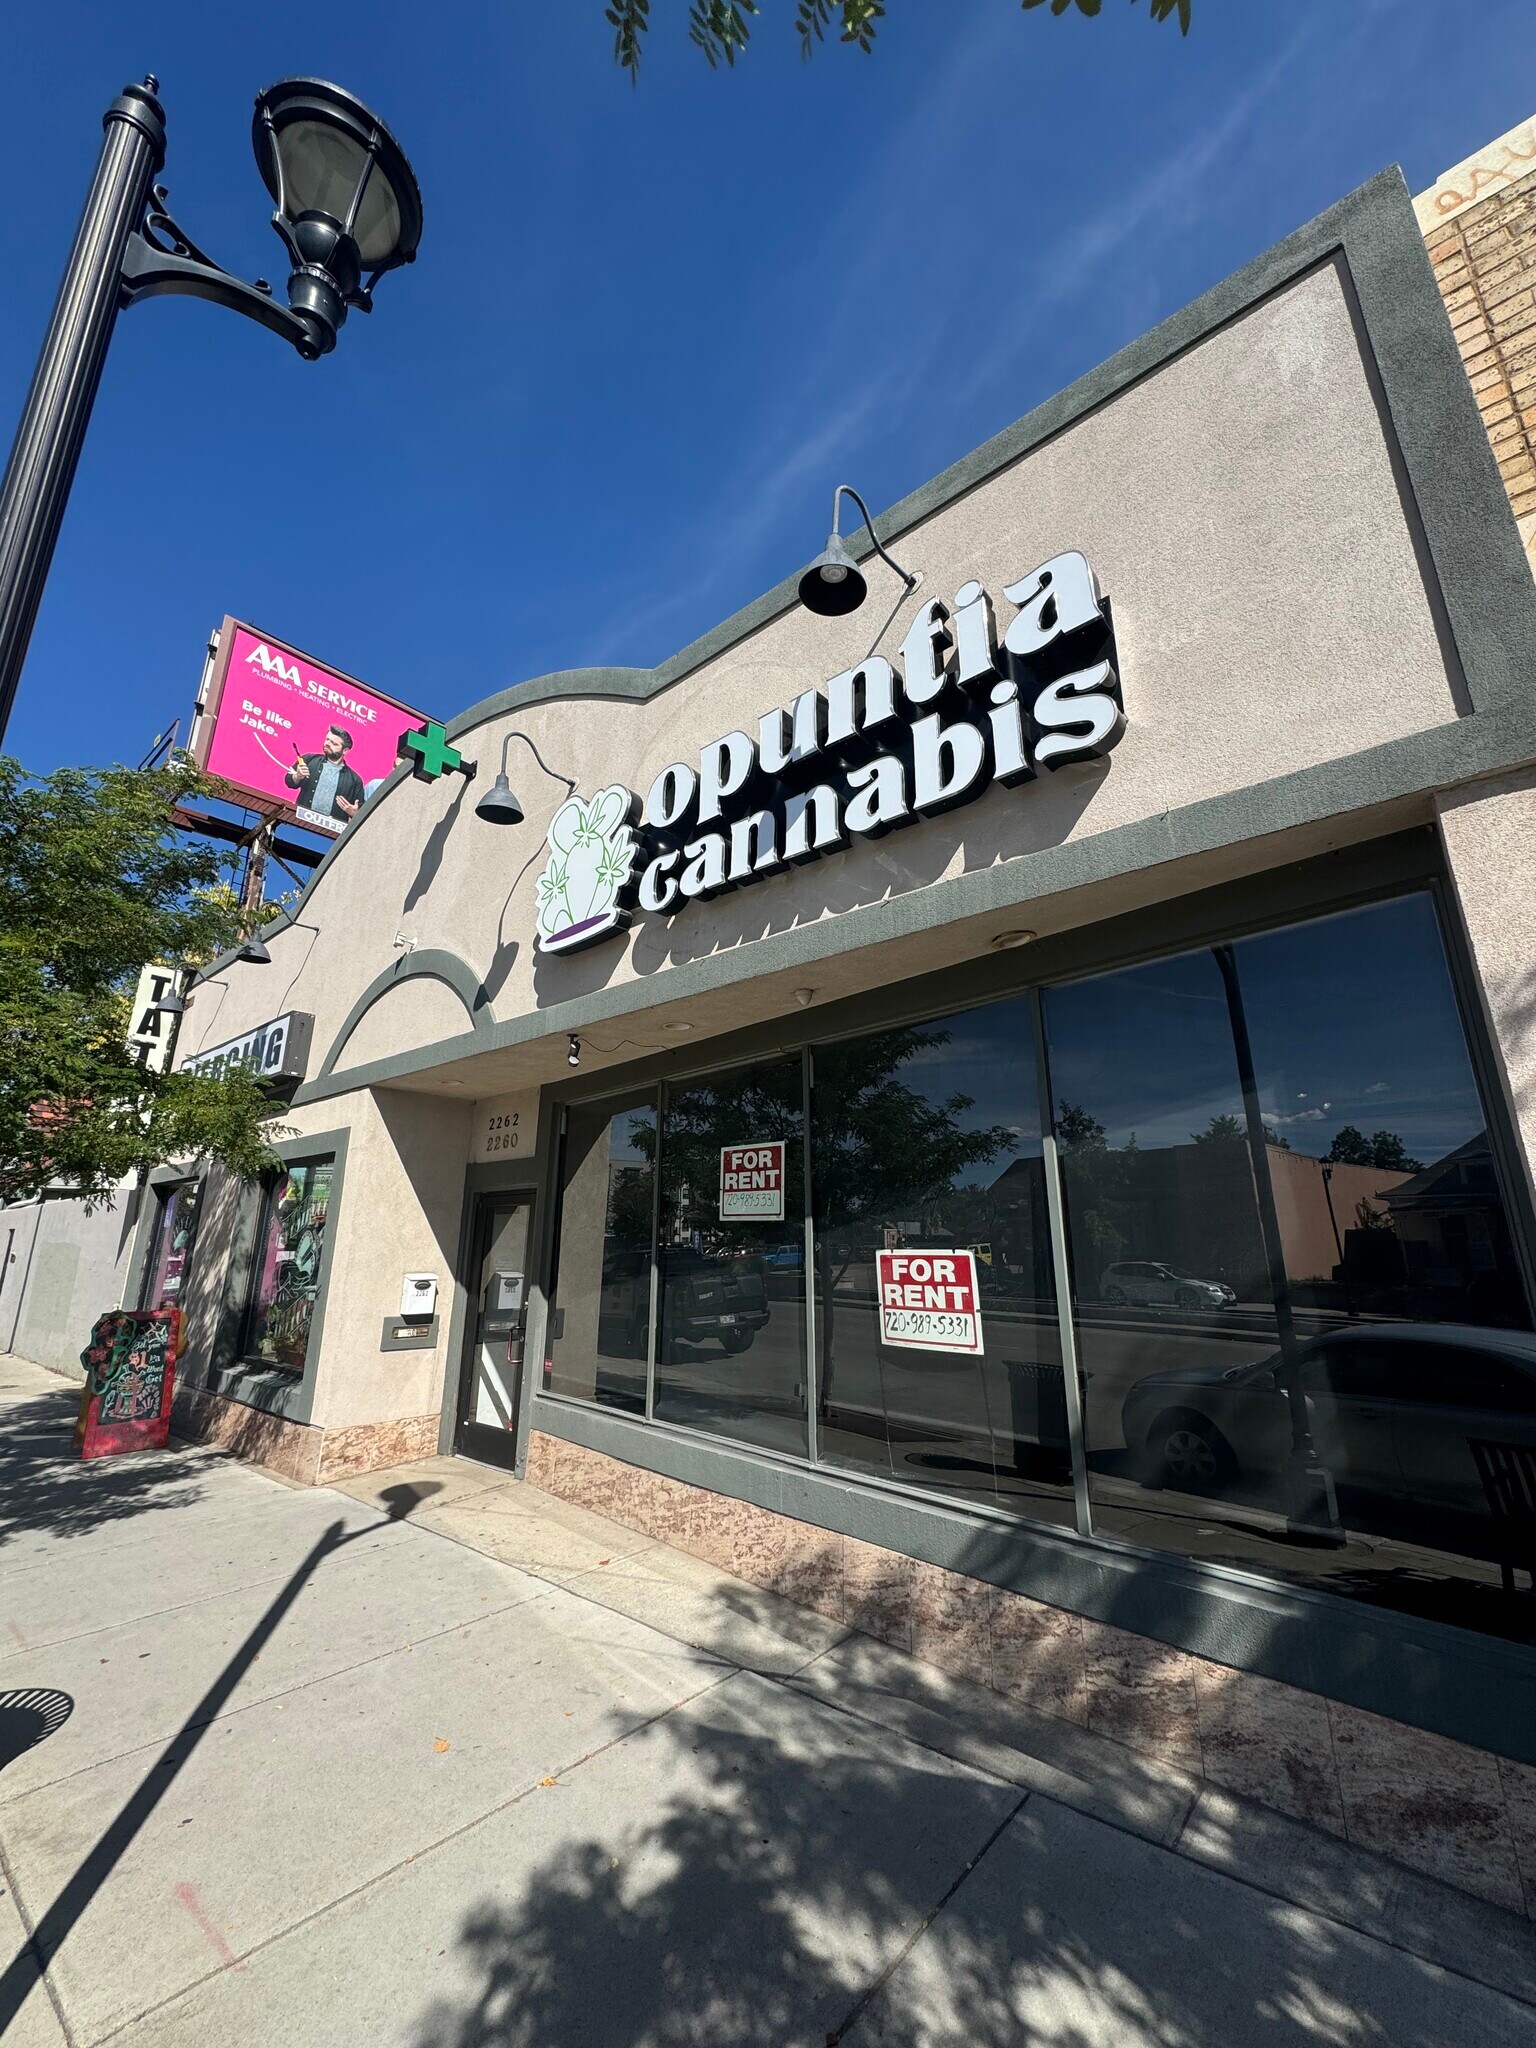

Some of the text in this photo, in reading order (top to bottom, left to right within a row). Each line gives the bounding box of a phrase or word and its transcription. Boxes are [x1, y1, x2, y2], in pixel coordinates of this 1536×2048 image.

[244, 643, 378, 723] AAA SERVICE
[646, 550, 1105, 829] opuntia
[252, 667, 368, 726] PLUMBING HEATING ELECTRIC
[239, 713, 279, 737] Jake.
[242, 699, 292, 729] Be like
[638, 659, 1124, 914] cannabis
[303, 810, 347, 833] OUTFR
[489, 1113, 520, 1131] 2262
[486, 1132, 519, 1152] 2260
[731, 1150, 773, 1170] FOR
[724, 1169, 780, 1190] RENT
[891, 1258, 957, 1283] FOR
[884, 1283, 970, 1310] RENT
